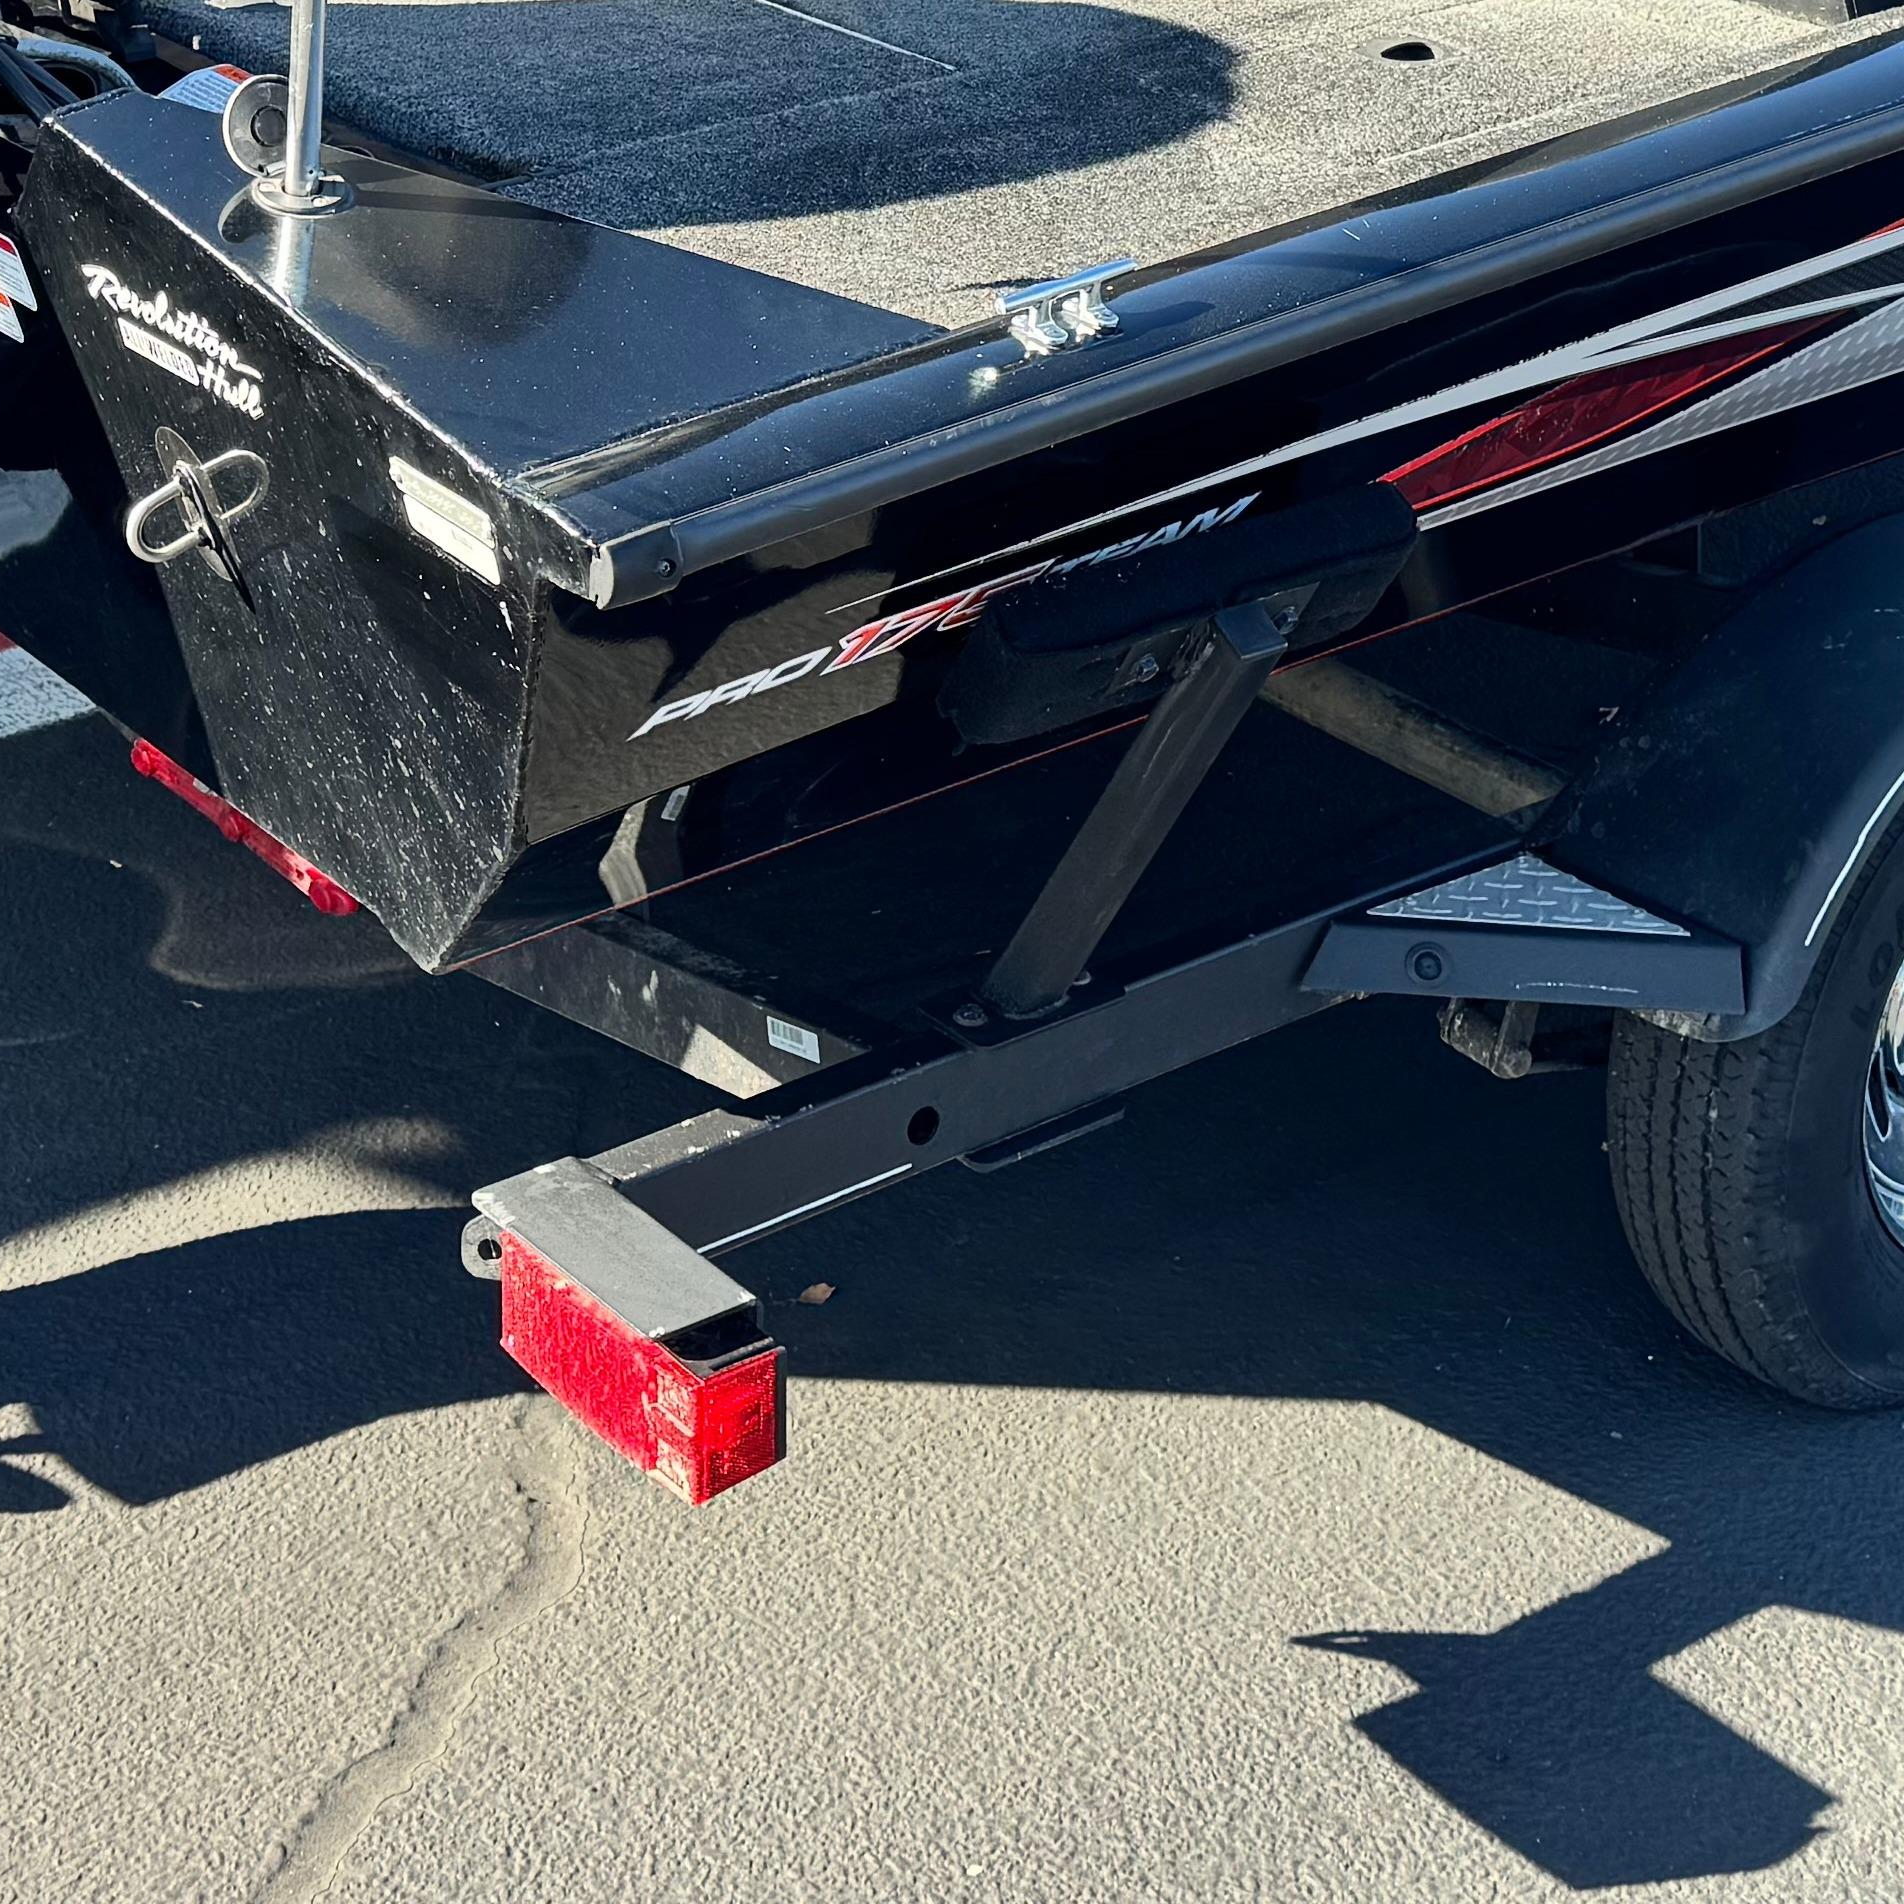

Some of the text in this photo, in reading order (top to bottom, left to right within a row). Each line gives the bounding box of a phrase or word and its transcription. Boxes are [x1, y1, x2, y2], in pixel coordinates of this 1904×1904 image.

[81, 264, 263, 383] Revolution
[197, 358, 264, 421] Hull
[626, 646, 834, 742] PRO
